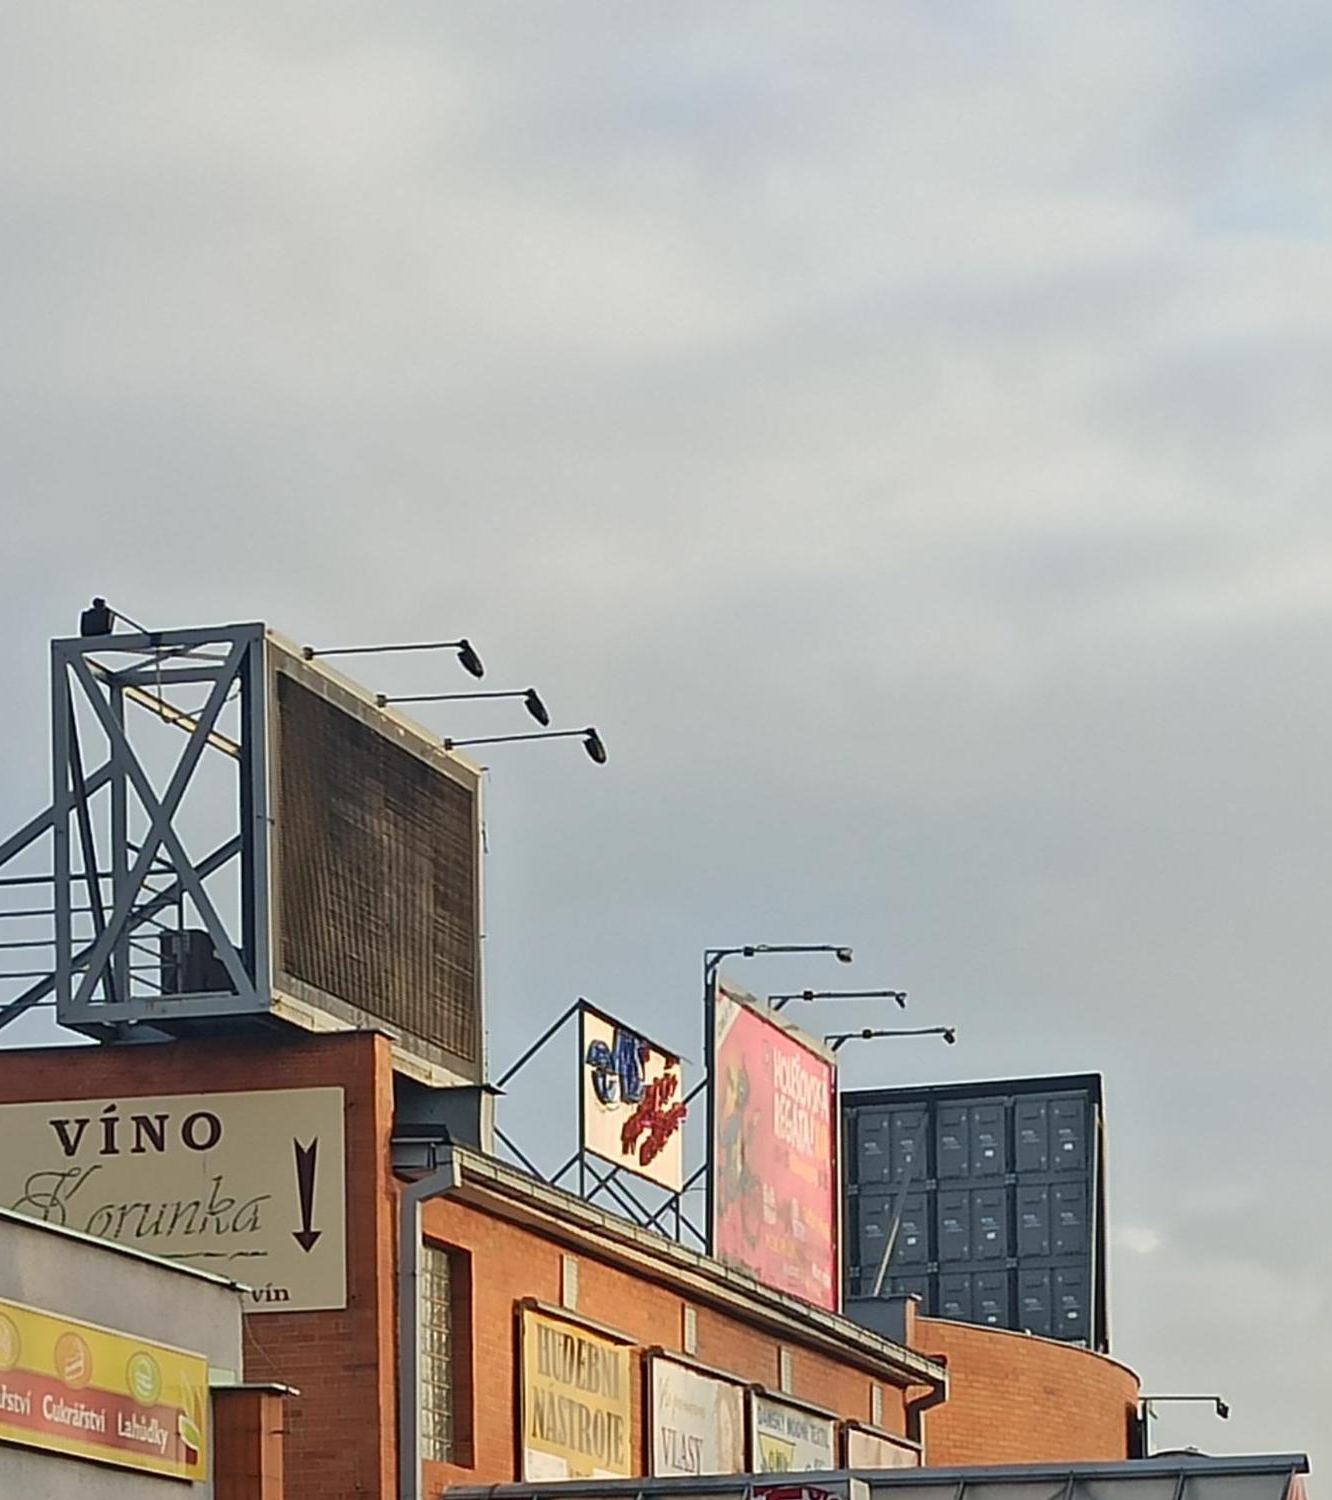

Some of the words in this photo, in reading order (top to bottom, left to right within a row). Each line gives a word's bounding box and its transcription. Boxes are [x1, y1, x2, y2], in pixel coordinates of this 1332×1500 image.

[49, 1103, 223, 1157] VÍNO
[9, 1164, 272, 1239] Korunka
[41, 1394, 106, 1434] Cukrářství
[117, 1411, 169, 1454] Lahůdky
[531, 1382, 625, 1468] NÁSTROJE
